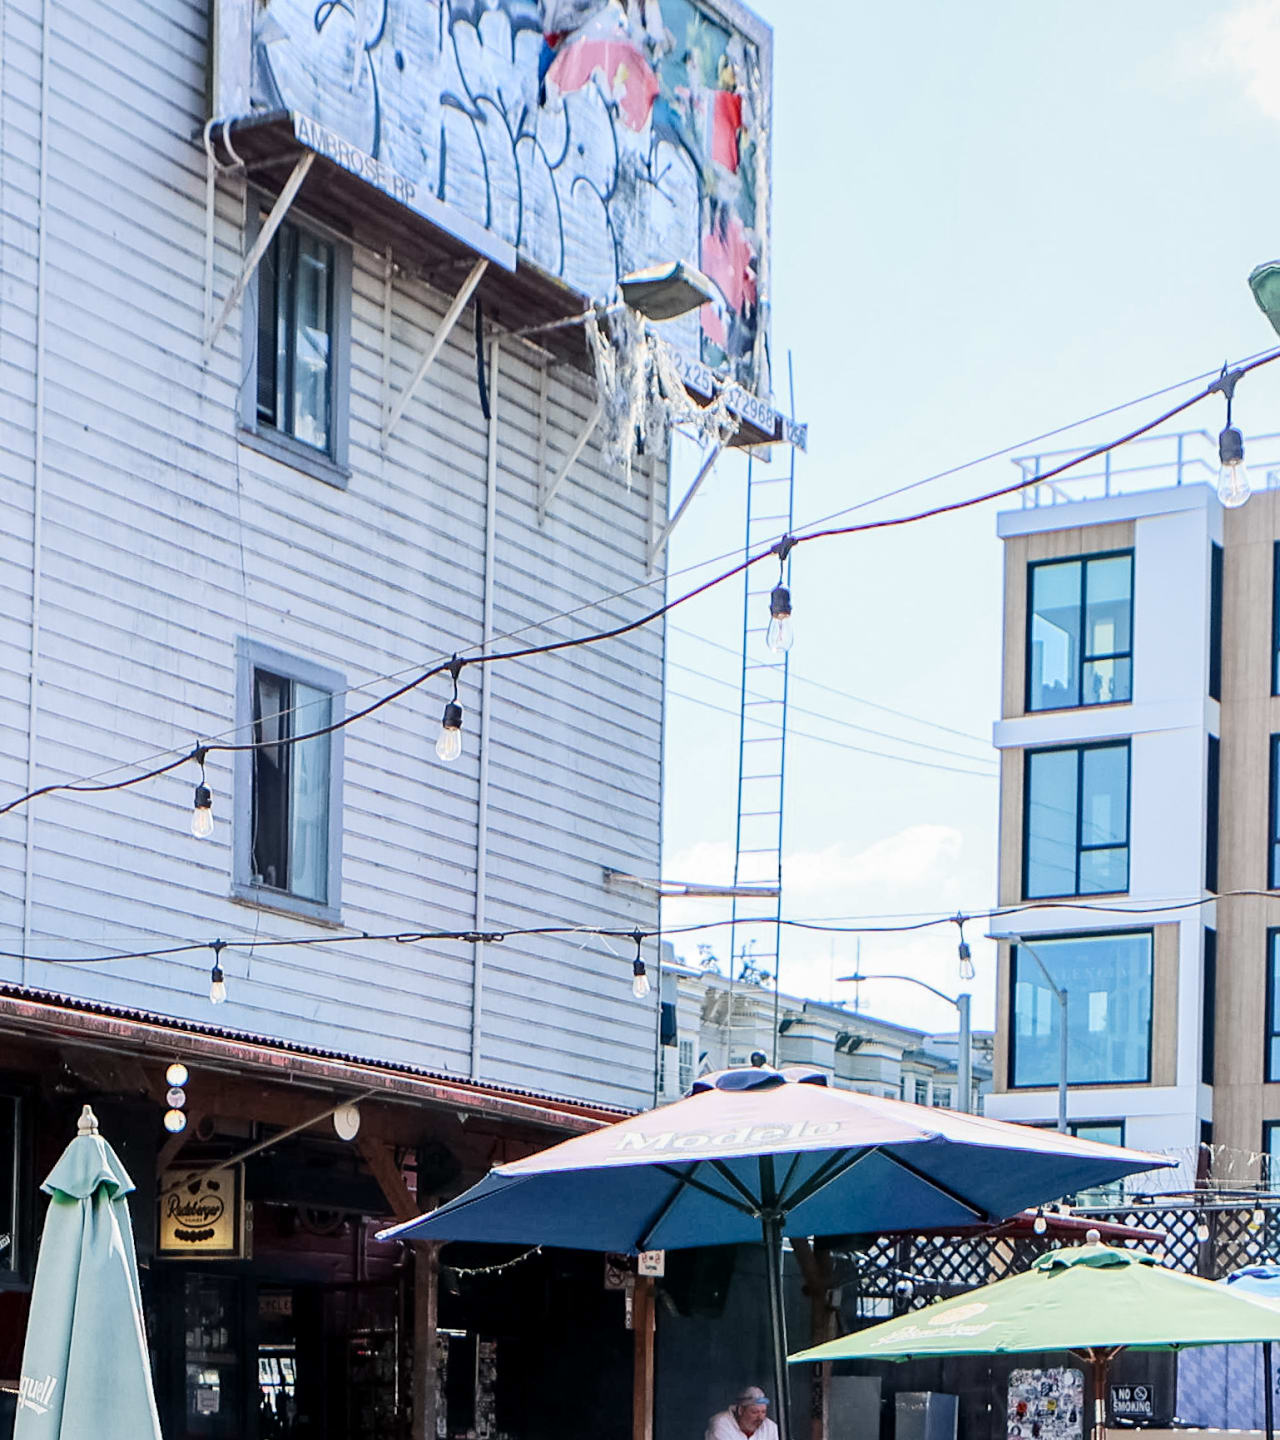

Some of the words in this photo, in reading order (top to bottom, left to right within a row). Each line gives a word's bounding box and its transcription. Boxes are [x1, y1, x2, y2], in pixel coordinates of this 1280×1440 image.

[615, 1119, 842, 1151] Modelo
[1118, 1389, 1131, 1400] NO
[1112, 1401, 1152, 1412] SMOKING
